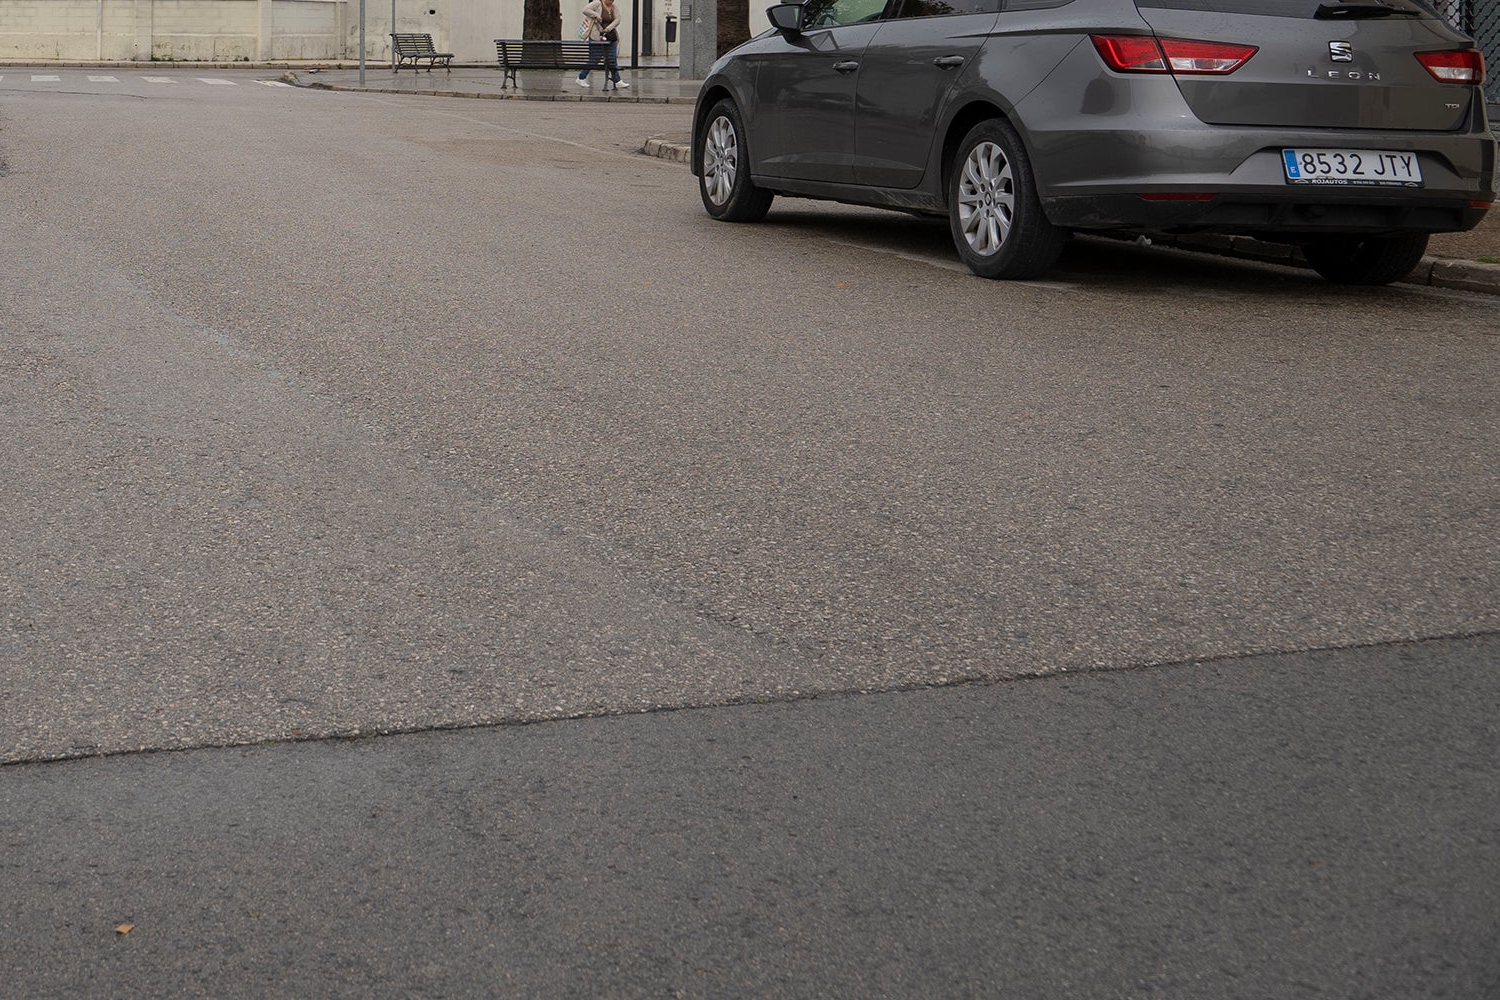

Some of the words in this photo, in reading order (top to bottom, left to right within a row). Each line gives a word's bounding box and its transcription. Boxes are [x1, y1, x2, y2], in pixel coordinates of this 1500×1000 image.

[1307, 70, 1381, 81] LEON
[1290, 166, 1297, 174] E
[1301, 153, 1365, 175] 8532
[1374, 154, 1412, 177] JTY
